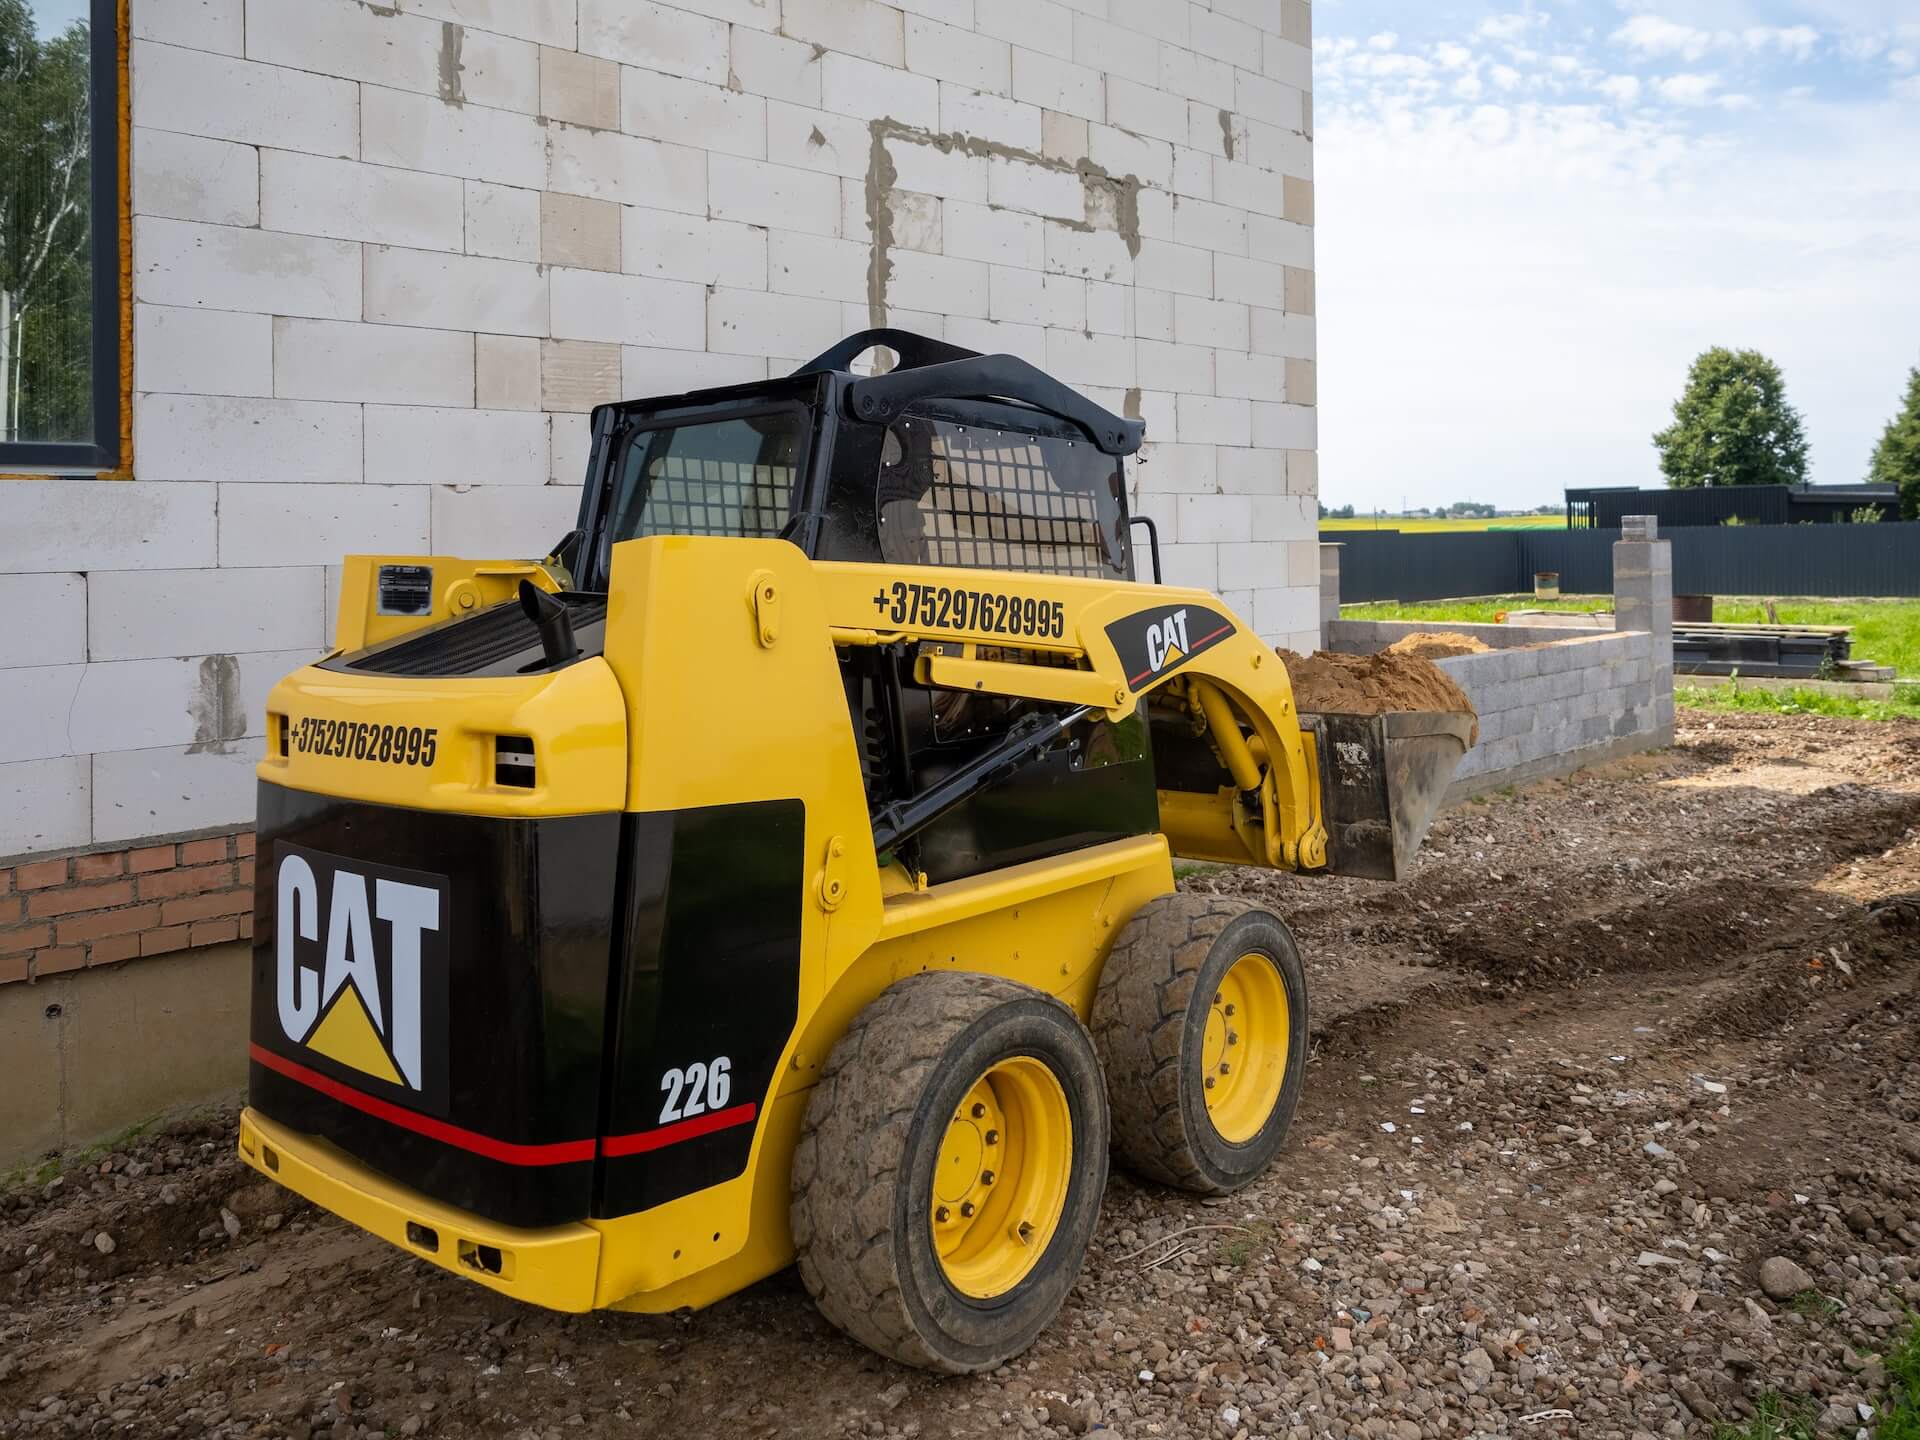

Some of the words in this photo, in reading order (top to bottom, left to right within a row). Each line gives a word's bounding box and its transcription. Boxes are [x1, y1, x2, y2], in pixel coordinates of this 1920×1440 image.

[873, 582, 1064, 639] +375297628995
[1146, 608, 1188, 673] CAT
[290, 717, 438, 767] +375297628995
[277, 854, 440, 1092] CAT
[659, 1056, 731, 1124] 226
